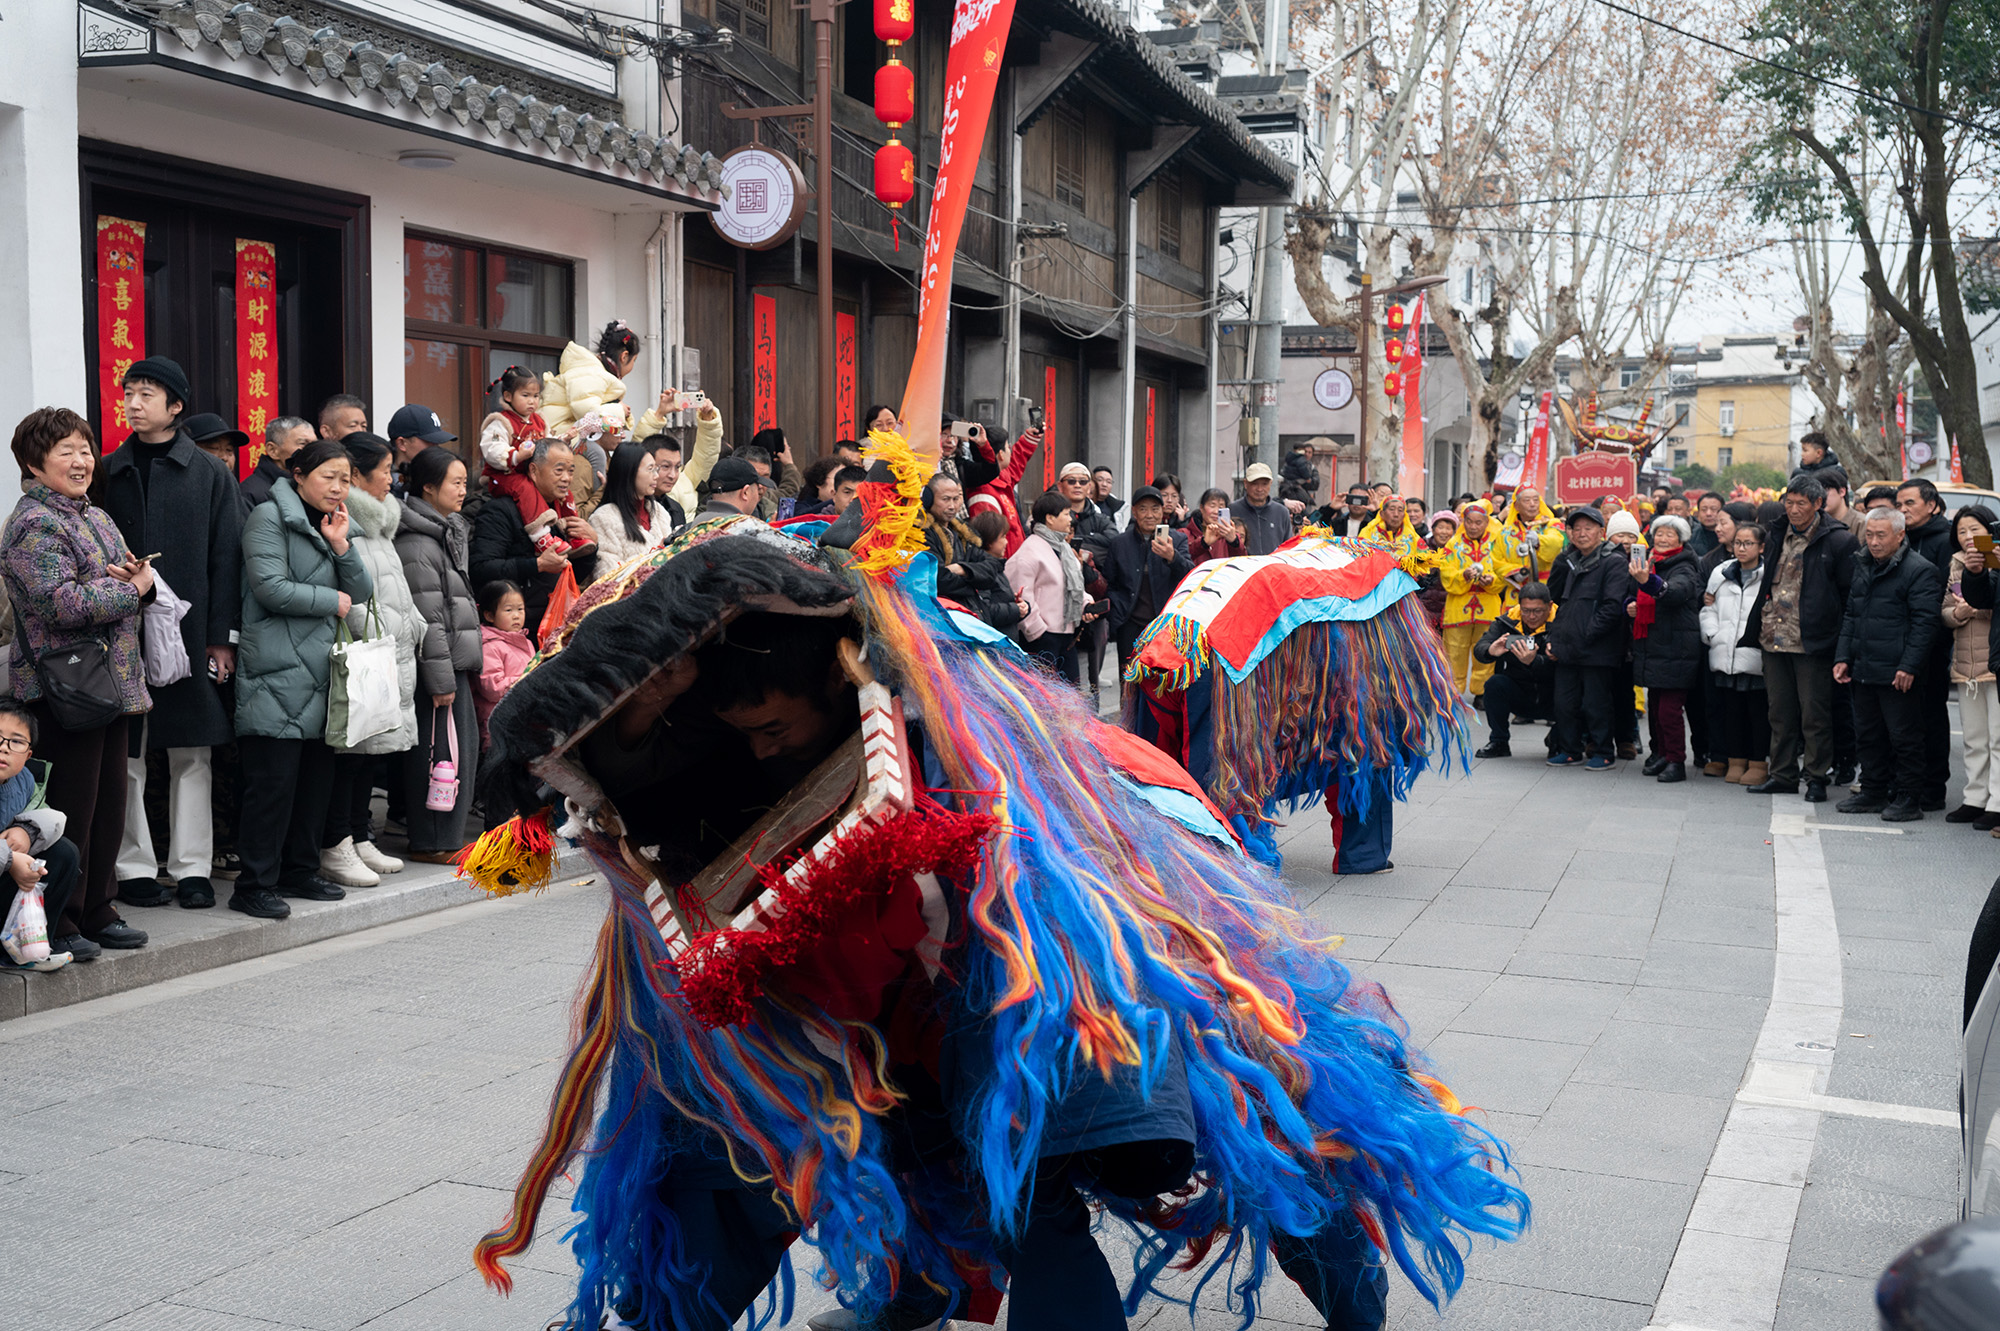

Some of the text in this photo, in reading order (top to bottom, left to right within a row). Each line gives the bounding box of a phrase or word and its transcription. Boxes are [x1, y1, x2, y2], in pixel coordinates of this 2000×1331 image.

[111, 277, 134, 446] 喜氣洋洋
[1567, 476, 1624, 489] 北村板龙舞
